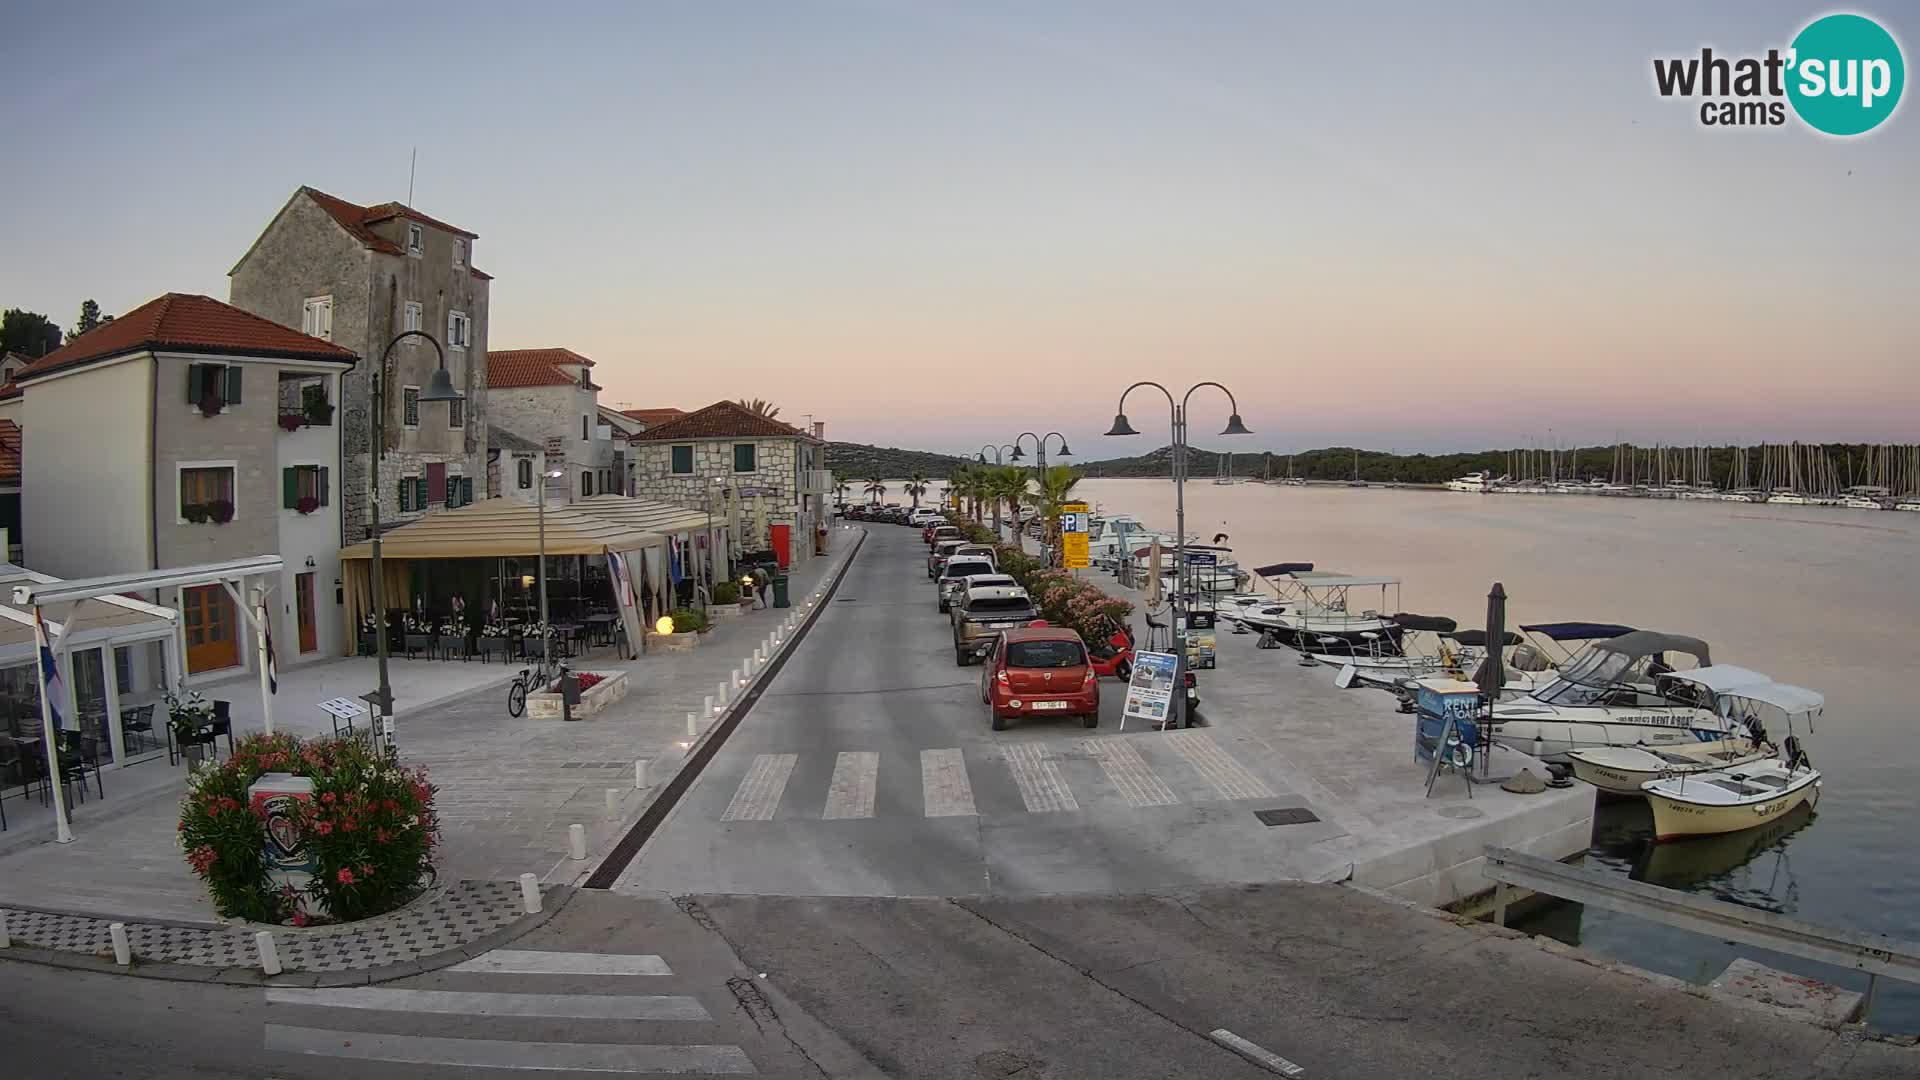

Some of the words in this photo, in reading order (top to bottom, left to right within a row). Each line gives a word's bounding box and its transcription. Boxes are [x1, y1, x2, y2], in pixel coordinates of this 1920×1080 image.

[1065, 514, 1075, 531] P
[1443, 698, 1477, 711] RENT
[1442, 711, 1450, 720] A
[1651, 715, 1670, 725] RENT
[1677, 716, 1694, 727] BOAT
